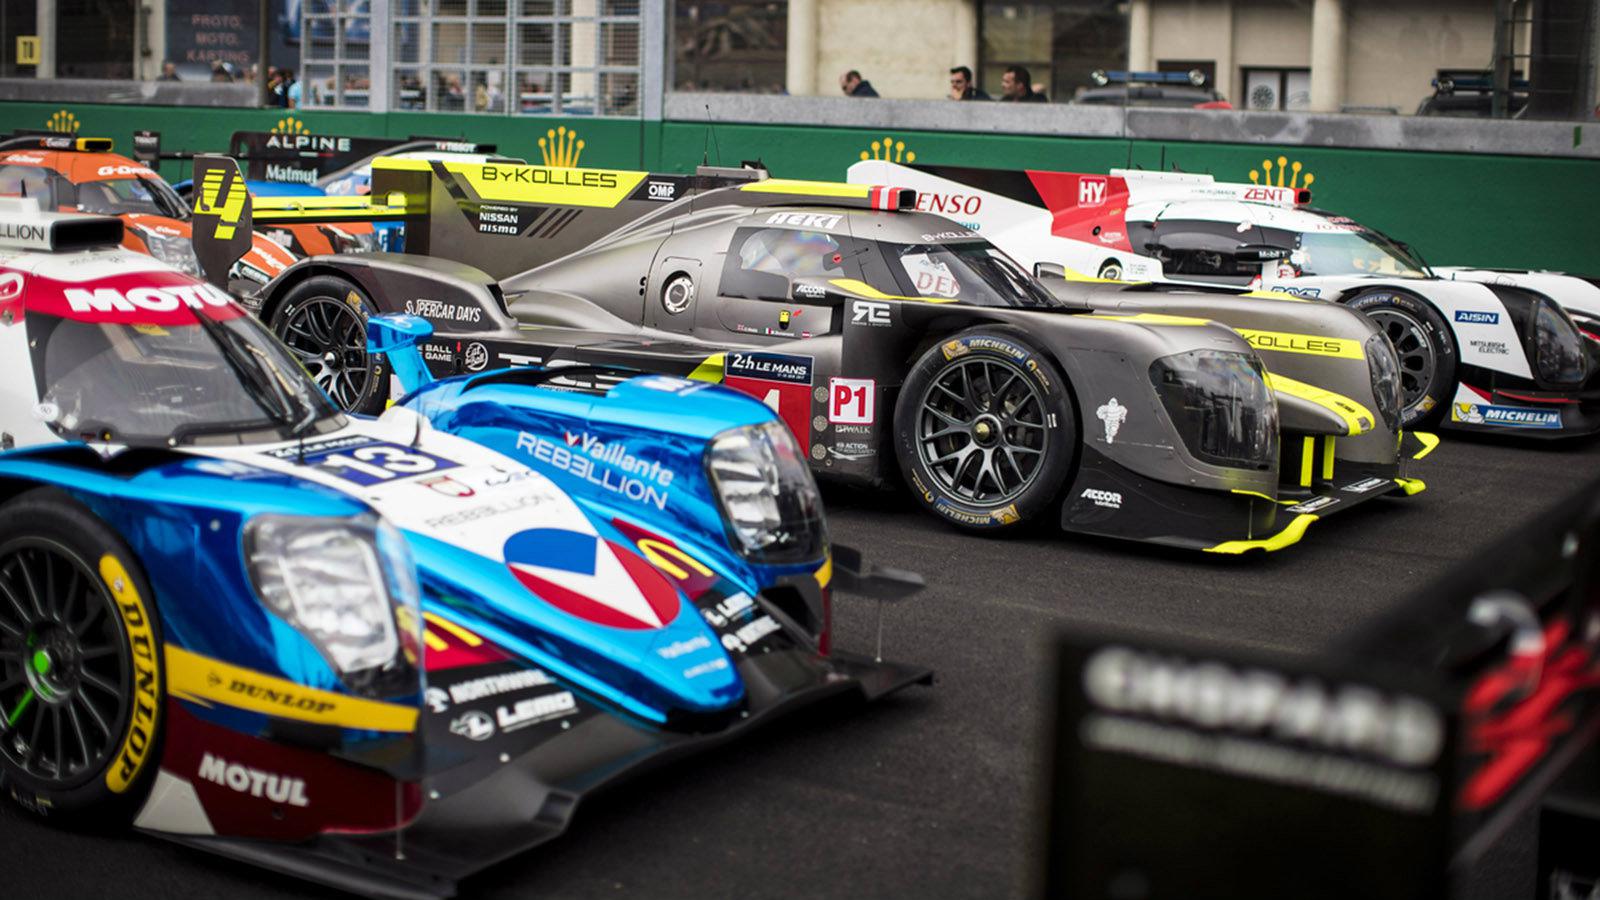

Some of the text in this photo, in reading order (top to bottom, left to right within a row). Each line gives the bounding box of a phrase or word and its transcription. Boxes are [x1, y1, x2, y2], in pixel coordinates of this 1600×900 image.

[266, 135, 351, 151] ALPINE
[265, 164, 319, 184] Matmut
[648, 185, 676, 197] OMP
[1080, 181, 1105, 203] HY
[1244, 188, 1284, 201] ZENT
[915, 192, 982, 215] ENSO
[480, 212, 518, 224] NISSAN
[916, 271, 960, 295] DEN
[63, 281, 234, 313] MOTU
[405, 300, 481, 323] SUPERCAR DAYS
[1458, 312, 1497, 324] AISIN
[425, 344, 452, 354] BALL
[969, 339, 1026, 359] MICHELIN
[1241, 334, 1341, 353] KOLLES
[1479, 347, 1509, 355] ELECTRIC
[425, 352, 452, 362] GAME
[756, 362, 771, 372] LE
[772, 364, 807, 375] MANS
[834, 385, 866, 418] P1
[1485, 409, 1558, 423] MICHELIN
[324, 446, 436, 480] 13
[581, 432, 675, 487] Vaillante
[1081, 488, 1122, 503] ACCOR
[936, 503, 991, 525] MICHELIN
[120, 600, 156, 784] DUNLOP
[227, 679, 338, 714] DUNLOP
[198, 752, 309, 808] MOTUL
